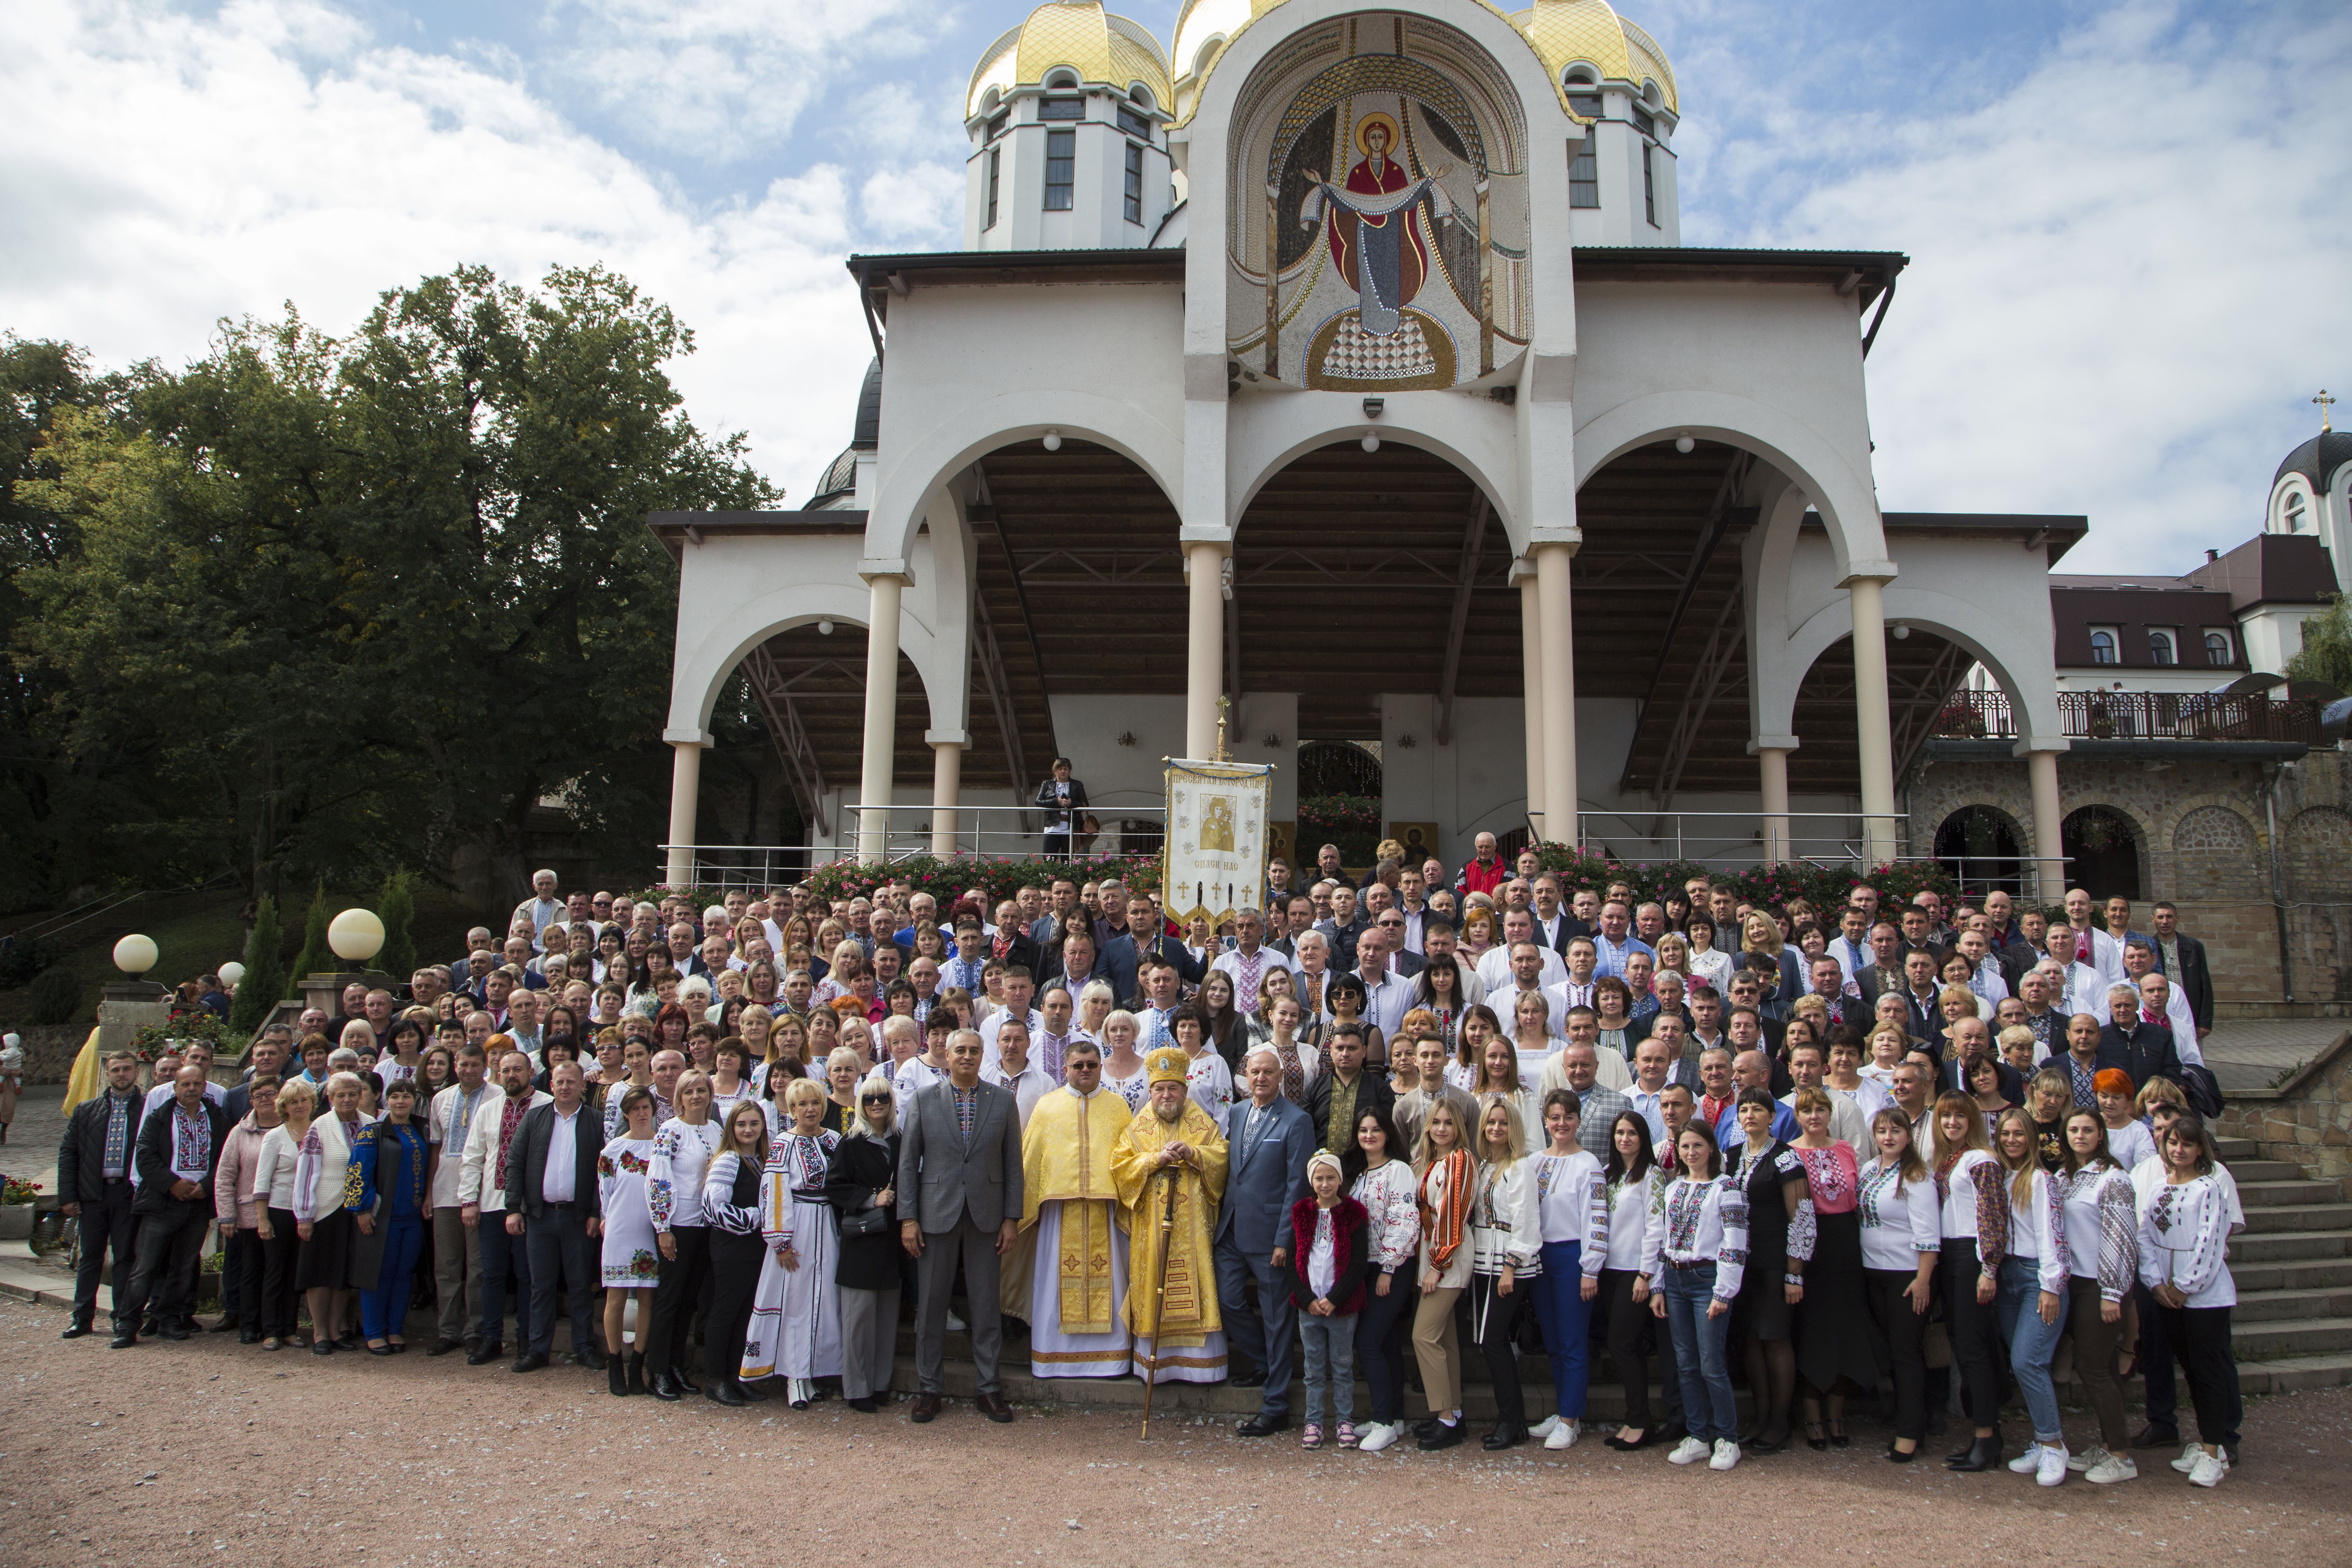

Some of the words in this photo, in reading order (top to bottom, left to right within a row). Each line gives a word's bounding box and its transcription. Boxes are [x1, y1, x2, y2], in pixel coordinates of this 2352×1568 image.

[1172, 774, 1217, 784] ПРЕСВЯТАЯ
[1194, 860, 1220, 869] СПАСИ
[1223, 861, 1239, 871] НАС
